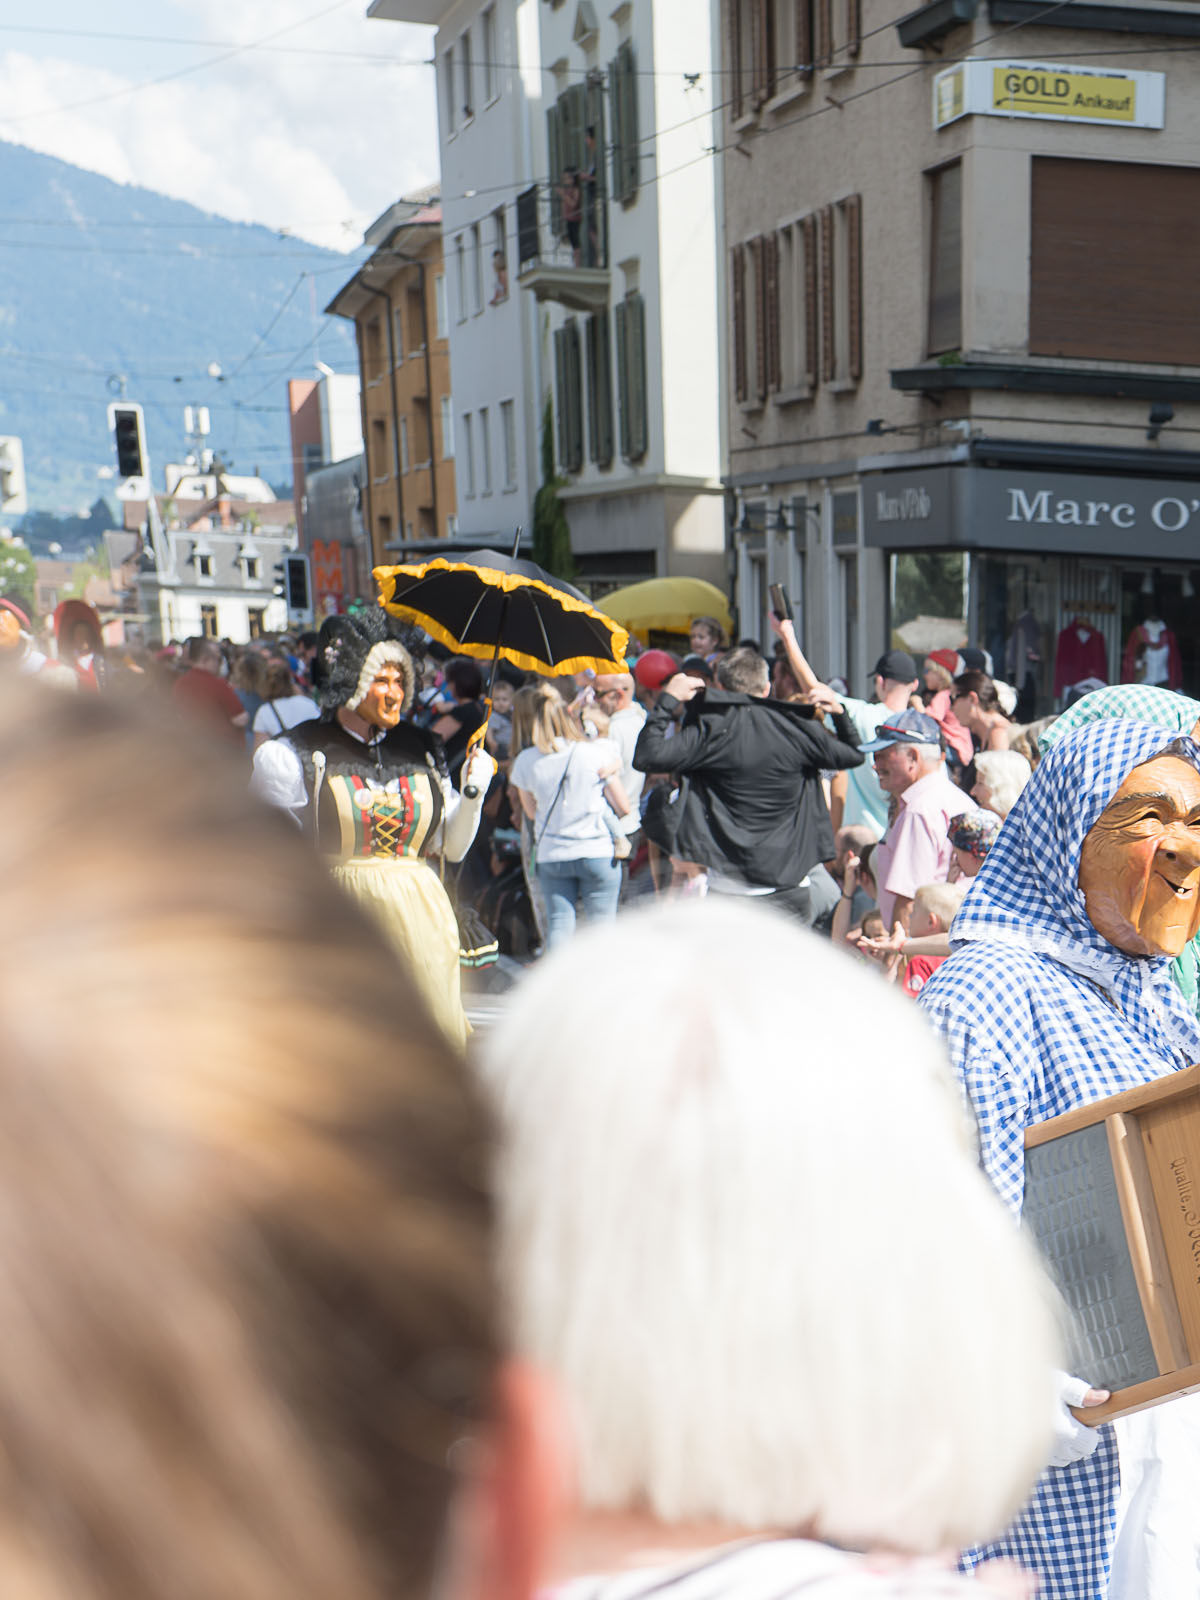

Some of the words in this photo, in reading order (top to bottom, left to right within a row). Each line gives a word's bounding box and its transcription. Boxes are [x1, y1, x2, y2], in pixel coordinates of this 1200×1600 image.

[1004, 73, 1070, 98] GOLD
[1073, 92, 1131, 111] Ankauf
[1006, 487, 1136, 528] Marc
